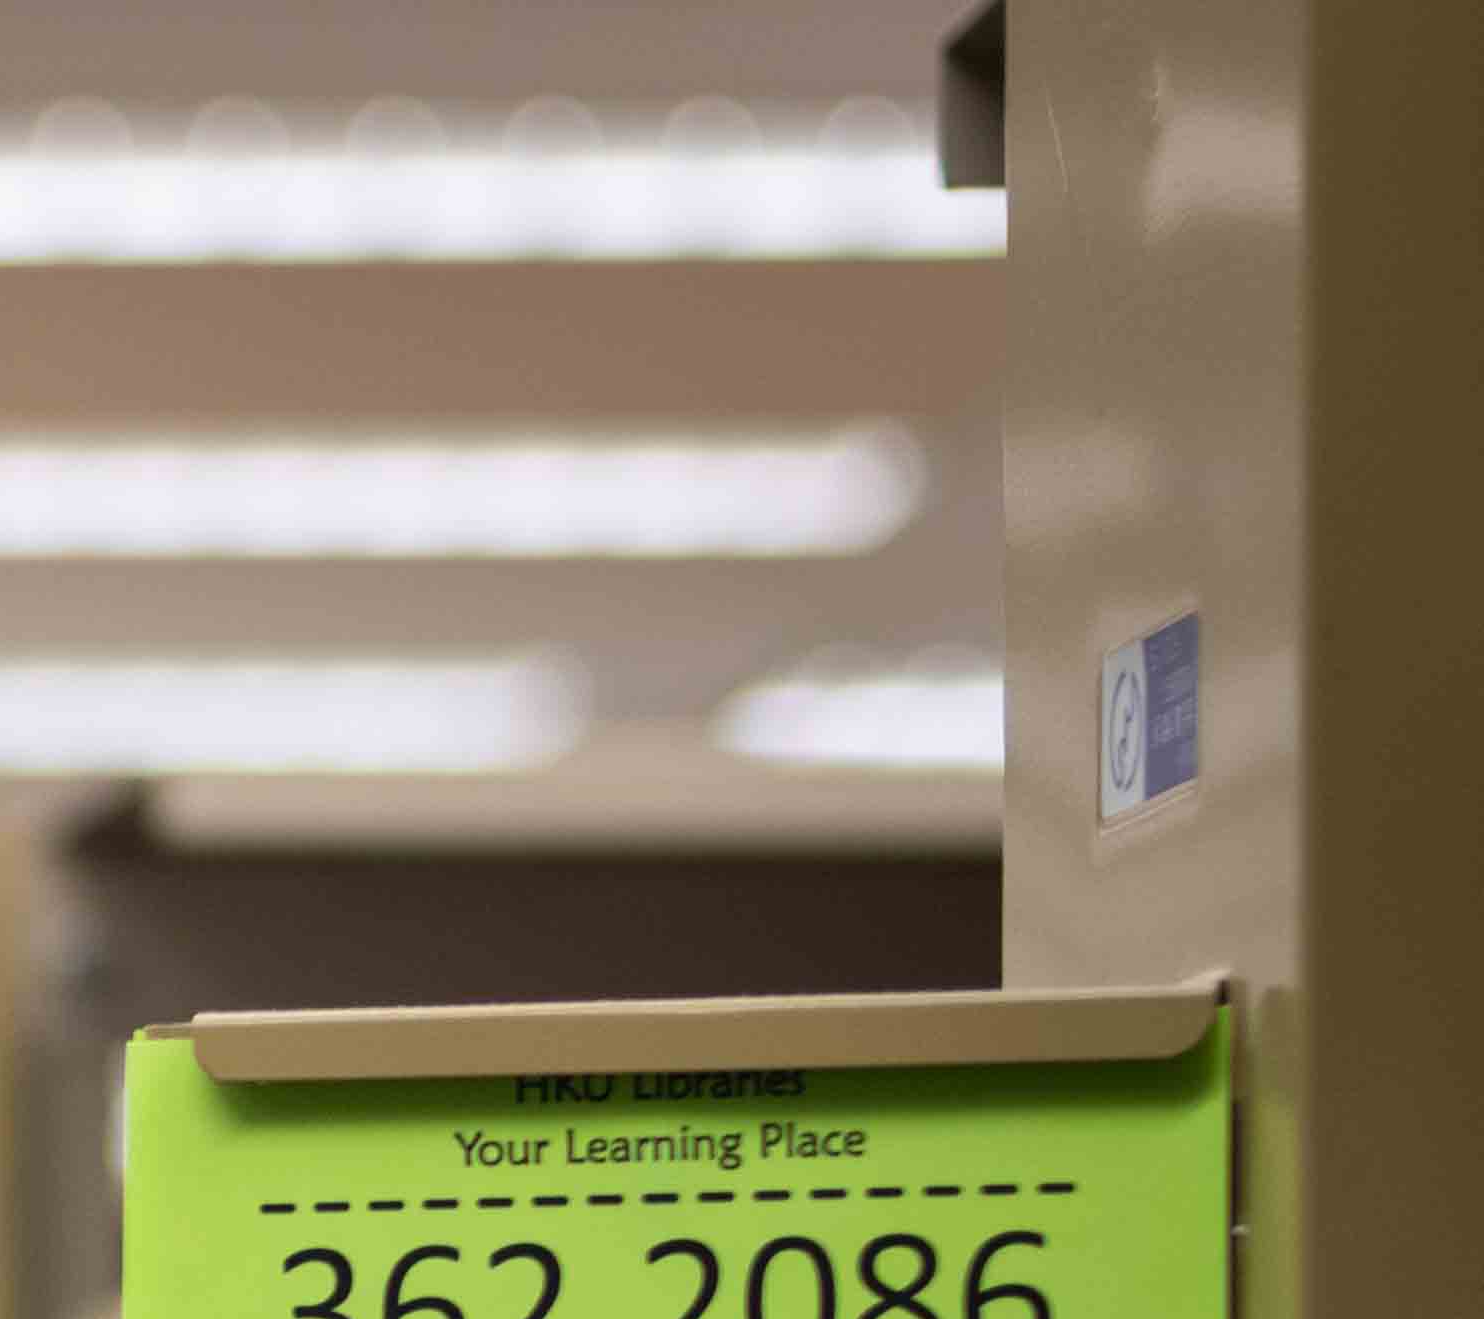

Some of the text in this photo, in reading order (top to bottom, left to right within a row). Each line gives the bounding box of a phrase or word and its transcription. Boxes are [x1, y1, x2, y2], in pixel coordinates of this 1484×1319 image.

[514, 1069, 807, 1104] HKU Libraries
[454, 1121, 867, 1170] Your Learning Place
